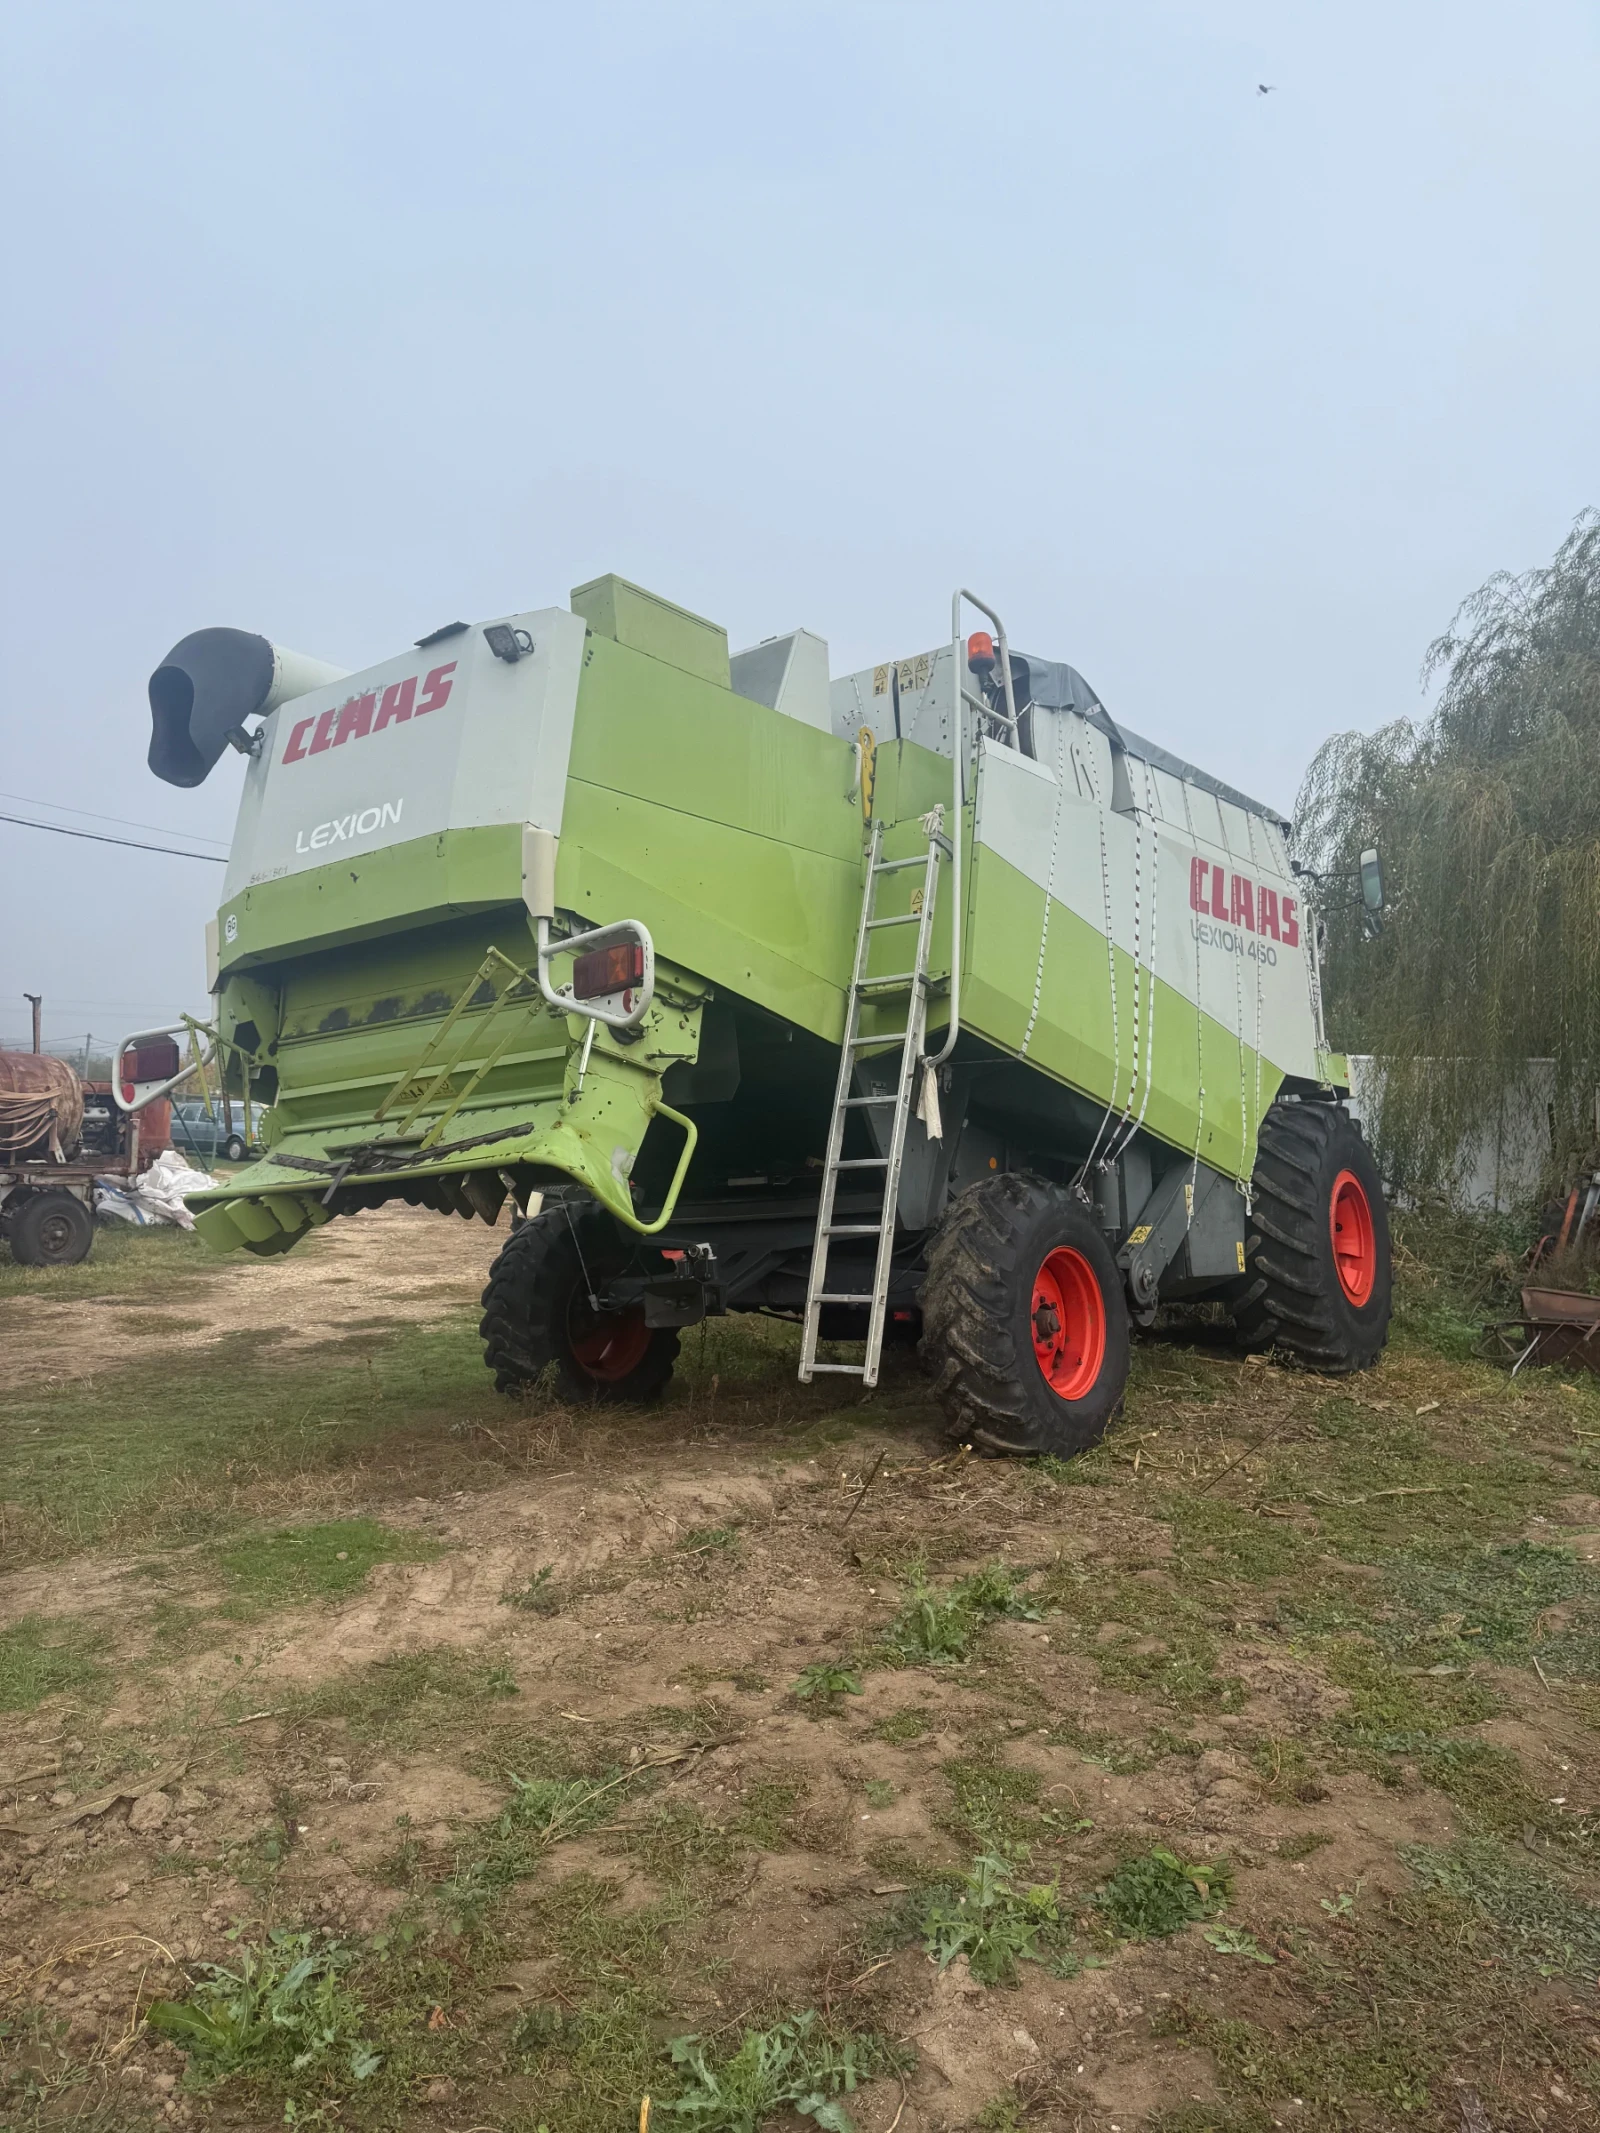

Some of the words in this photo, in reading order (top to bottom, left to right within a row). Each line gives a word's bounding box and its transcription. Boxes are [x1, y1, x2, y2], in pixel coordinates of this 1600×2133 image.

[281, 660, 458, 765] CLAAS
[295, 798, 403, 854] LEXION
[1189, 856, 1299, 948] CLAAS
[1190, 919, 1244, 956] LEXION
